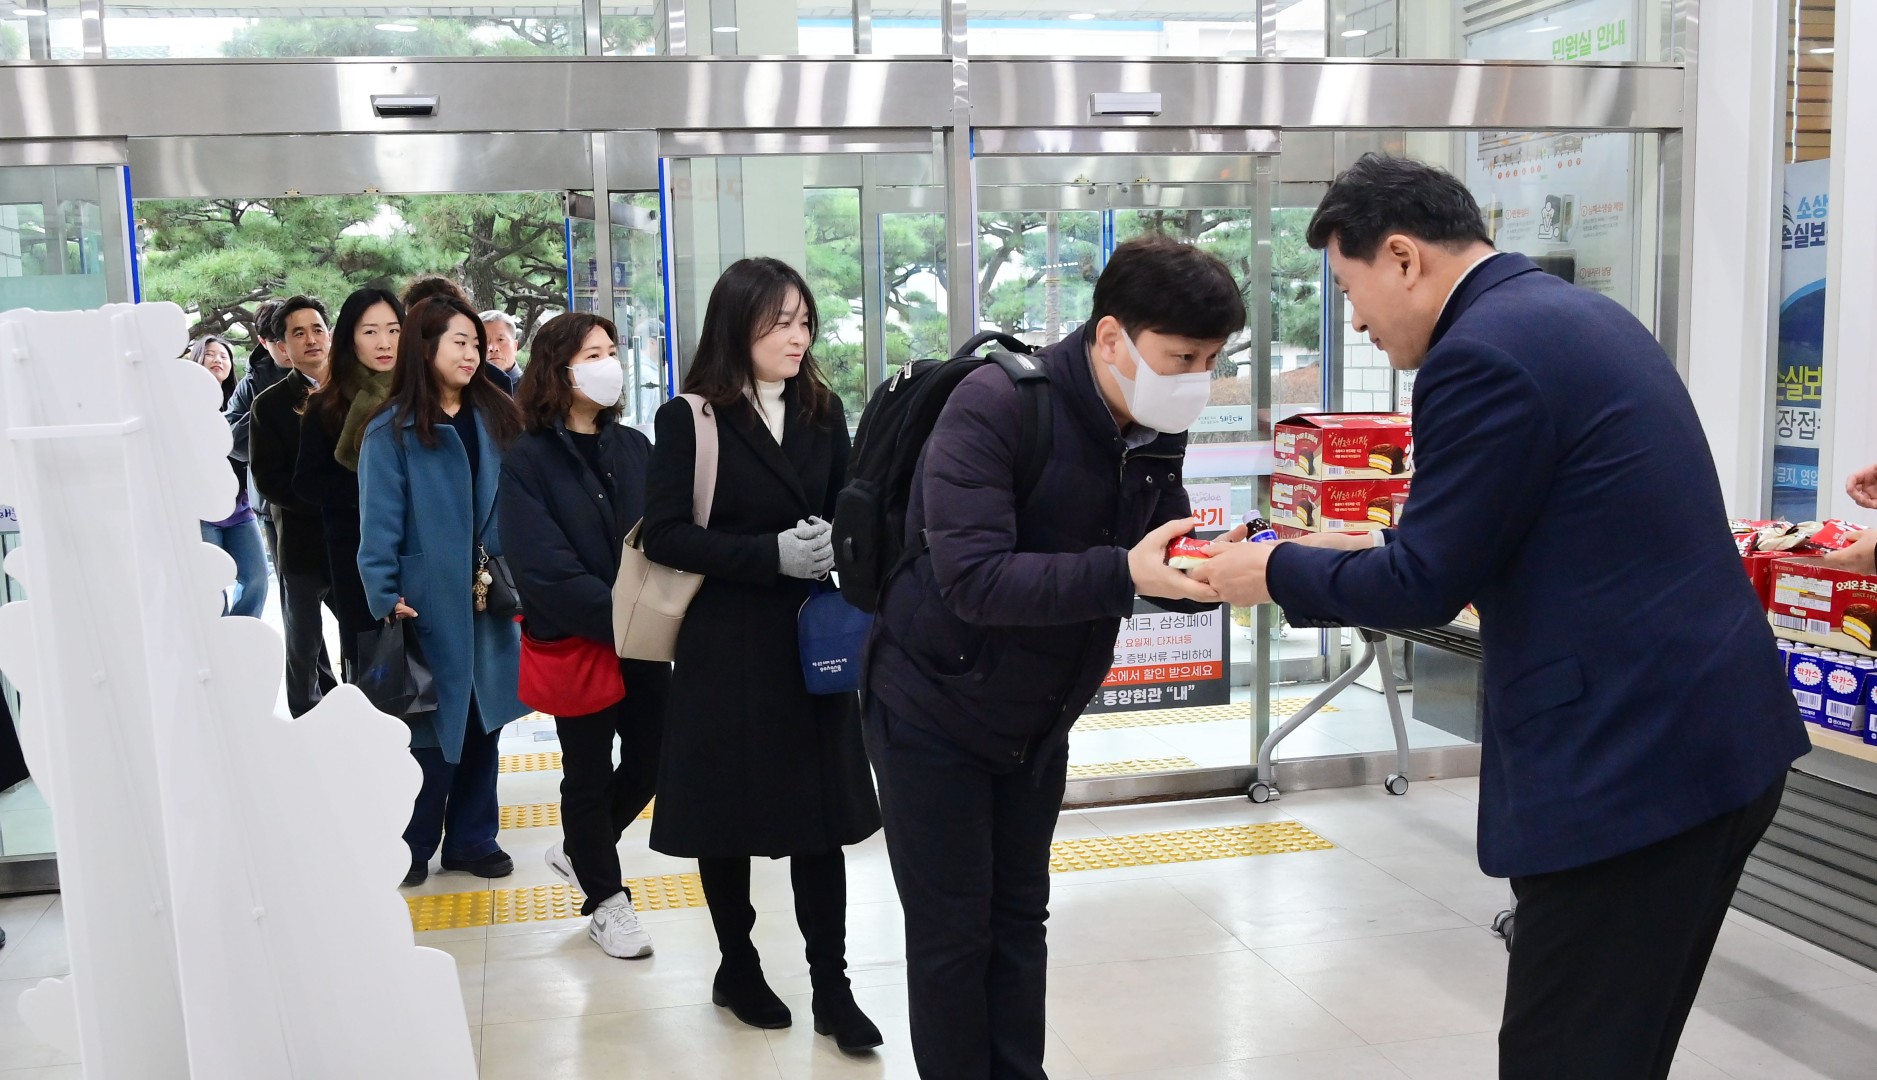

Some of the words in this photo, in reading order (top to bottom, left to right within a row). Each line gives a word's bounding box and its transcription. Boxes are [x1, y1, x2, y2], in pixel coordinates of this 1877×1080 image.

[1552, 30, 1592, 60] 민원실
[1597, 19, 1625, 51] 안내
[1782, 221, 1827, 249] 손실보
[1777, 409, 1821, 440] 장접
[1774, 466, 1798, 484] 금지,
[1836, 580, 1859, 592] 오리온
[1125, 617, 1155, 631] 체크,
[1160, 613, 1212, 630] 삼성페이
[1125, 637, 1154, 647] 요일제,
[1157, 634, 1192, 646] 다자녀등
[1127, 651, 1167, 664] 증빙서류
[1171, 648, 1212, 661] 구비하여
[1103, 670, 1140, 683] 소에서
[1143, 669, 1165, 681] 할인
[1169, 664, 1213, 678] 받으세요
[1798, 667, 1819, 679] 박카스
[1831, 674, 1854, 687] 박카스
[1103, 687, 1162, 706] 중앙현관
